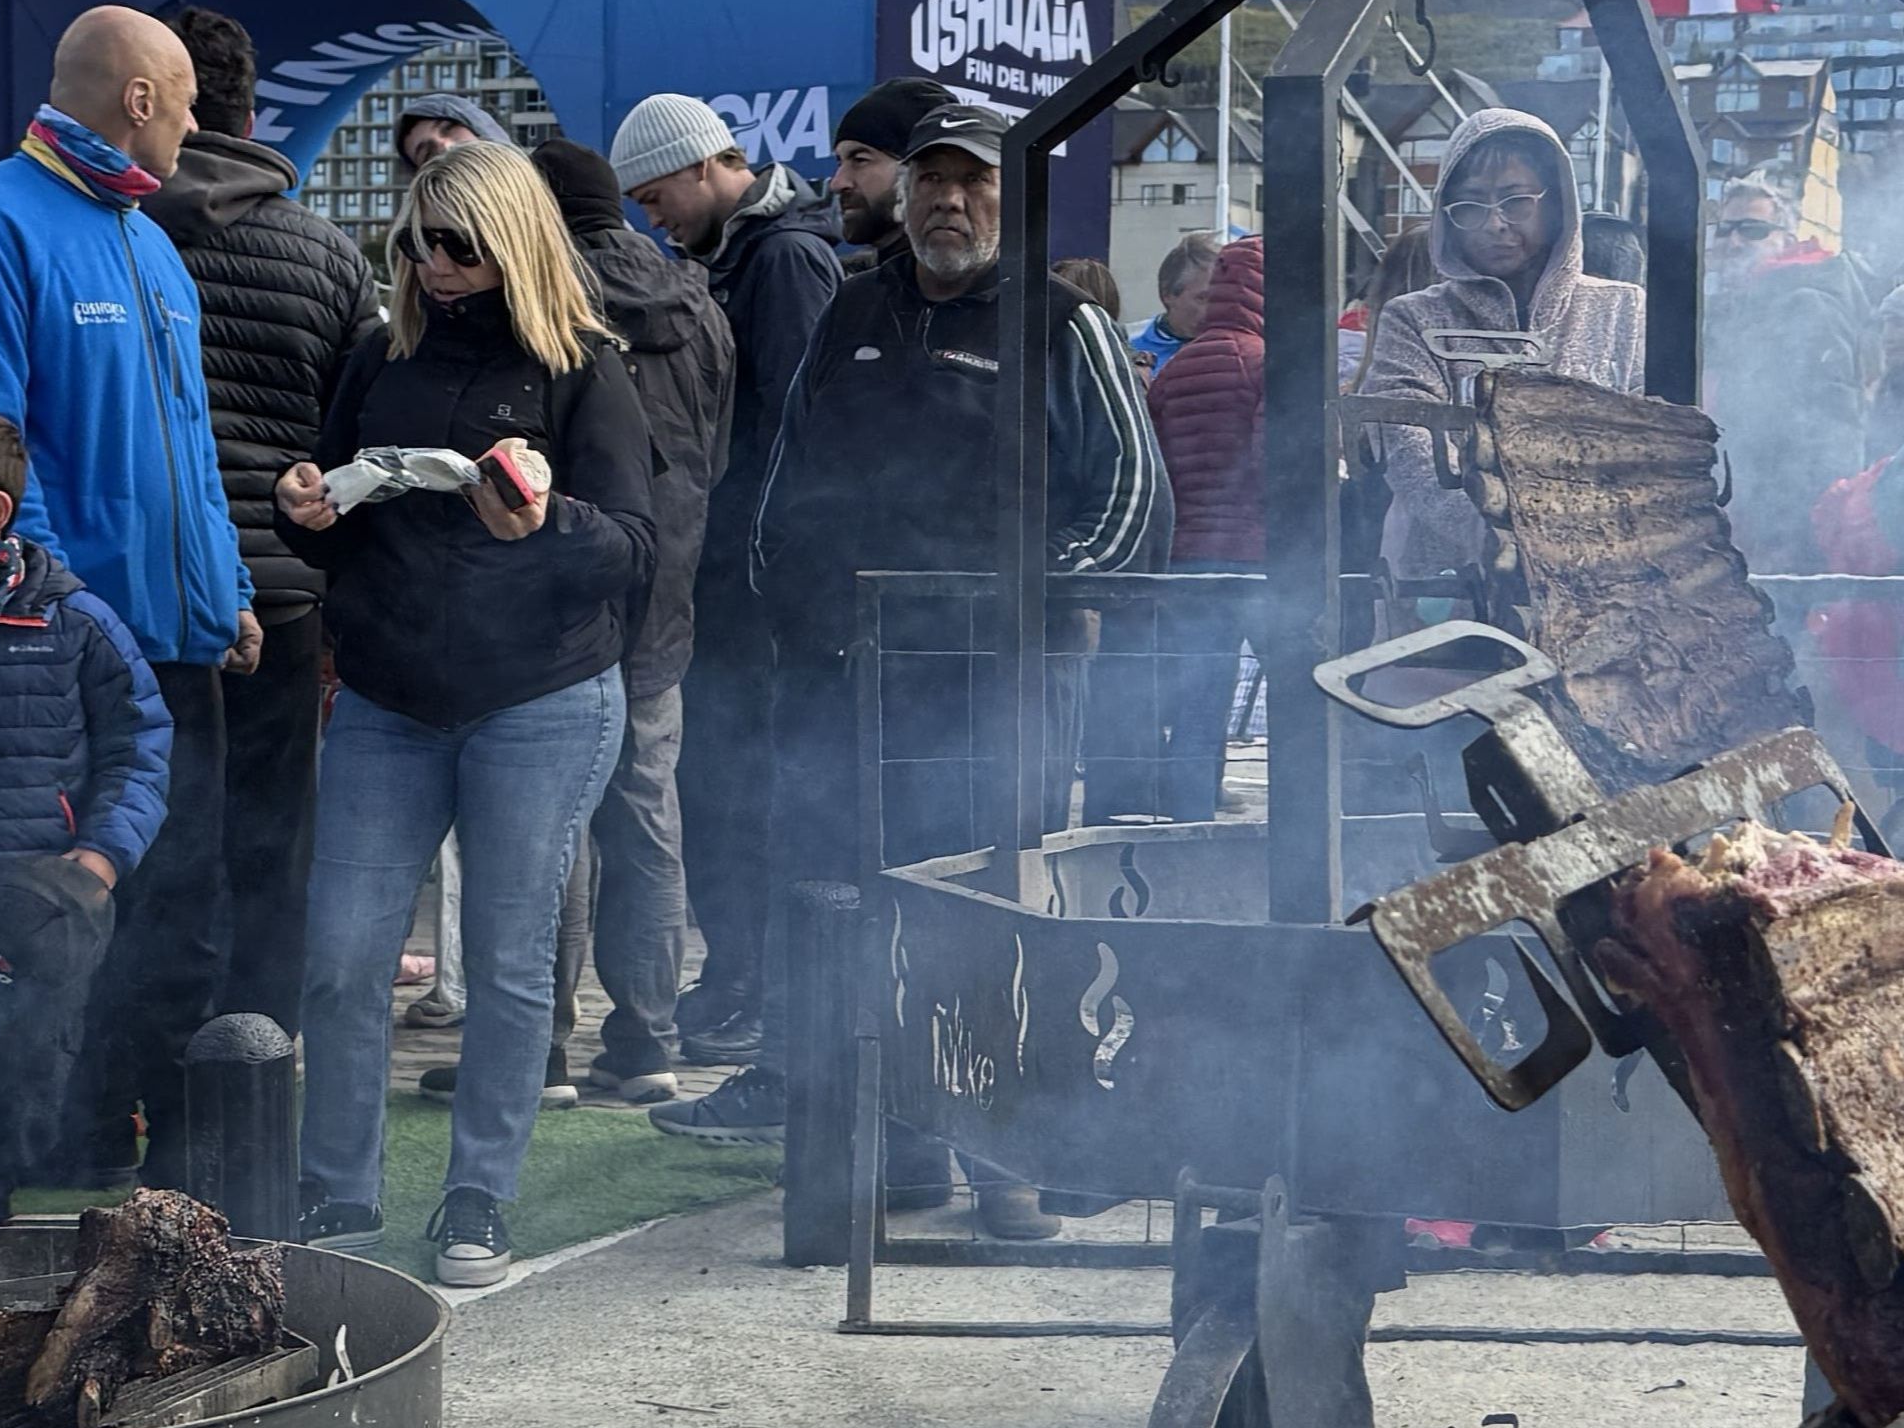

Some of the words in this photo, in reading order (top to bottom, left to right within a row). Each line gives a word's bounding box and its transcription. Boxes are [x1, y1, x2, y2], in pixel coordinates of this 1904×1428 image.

[965, 57, 993, 85] FIN
[996, 65, 1029, 93] DEL
[699, 86, 831, 164] OKA
